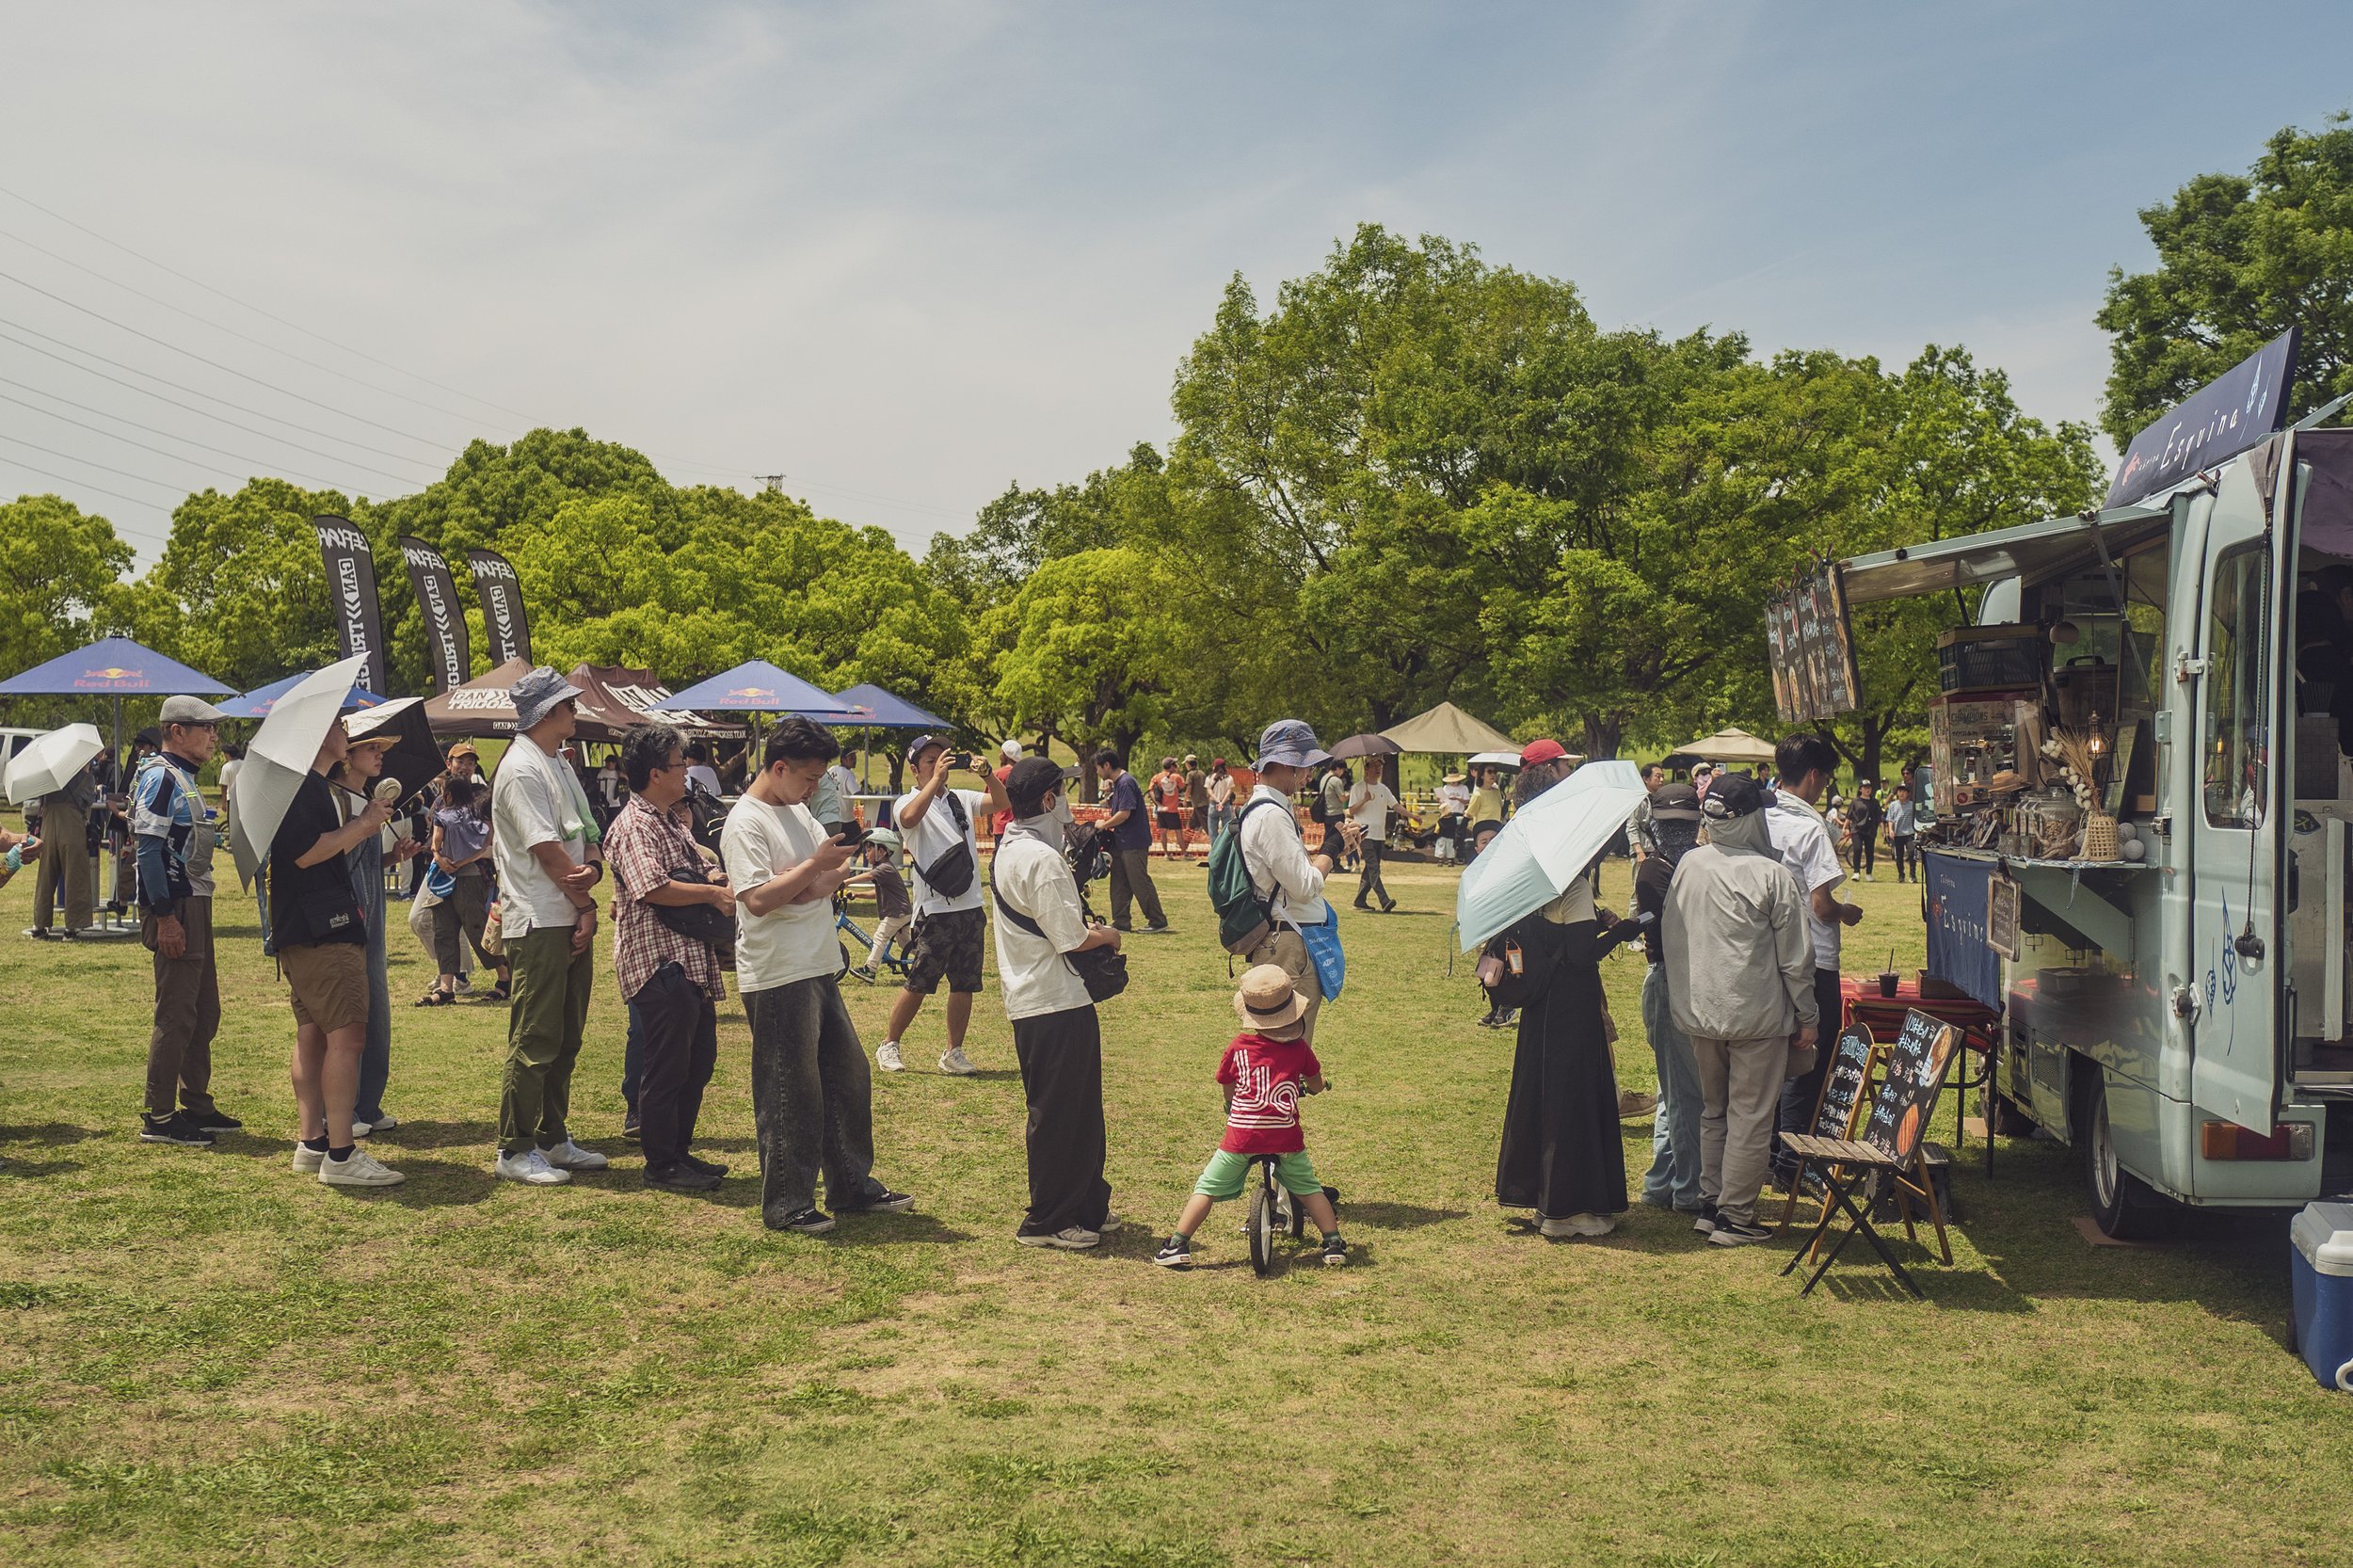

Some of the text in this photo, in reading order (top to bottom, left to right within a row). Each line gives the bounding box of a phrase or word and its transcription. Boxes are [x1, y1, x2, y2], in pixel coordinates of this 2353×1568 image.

[2160, 408, 2238, 471] Esquina
[74, 679, 150, 688] Red Bull
[847, 922, 873, 945] STRIDER
